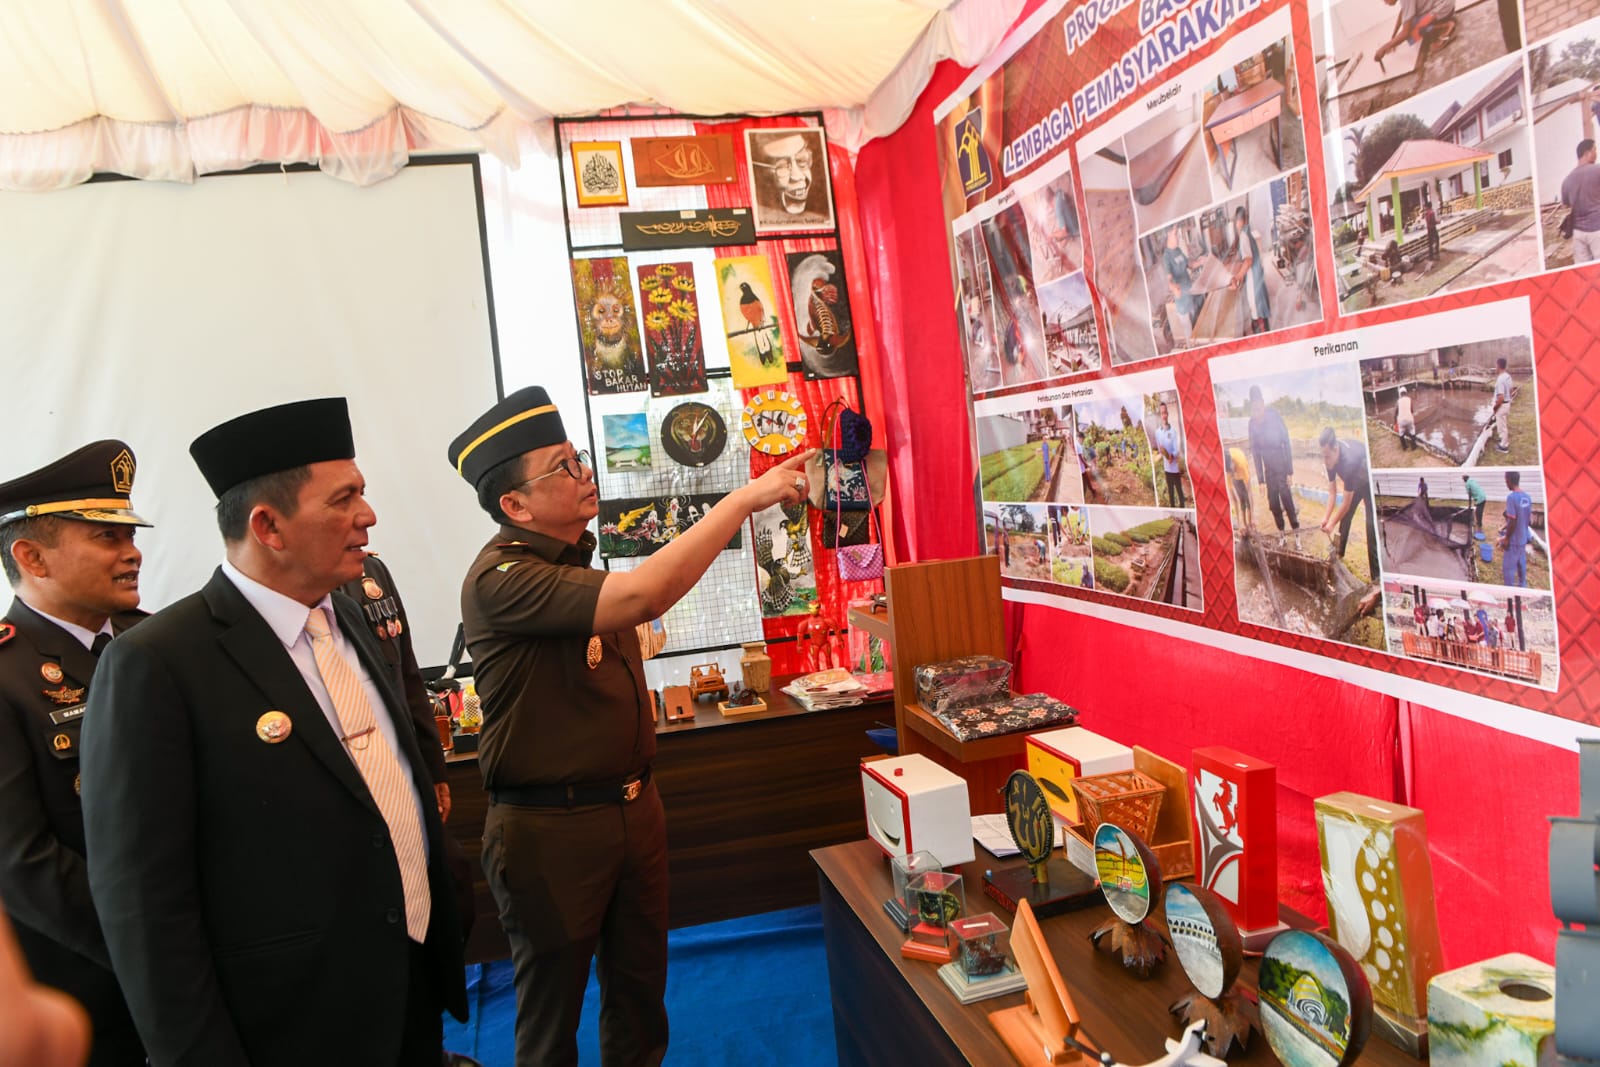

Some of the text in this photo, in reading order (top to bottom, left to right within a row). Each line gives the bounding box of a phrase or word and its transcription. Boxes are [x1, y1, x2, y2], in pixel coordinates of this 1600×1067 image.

[1065, 0, 1127, 51] PROG
[1146, 83, 1182, 111] Meubelair
[1004, 107, 1073, 175] LEMBAGA
[1313, 341, 1358, 356] Perikanan
[594, 369, 623, 380] STOP
[605, 374, 639, 387] BAKAR
[616, 382, 647, 392] HUTAN
